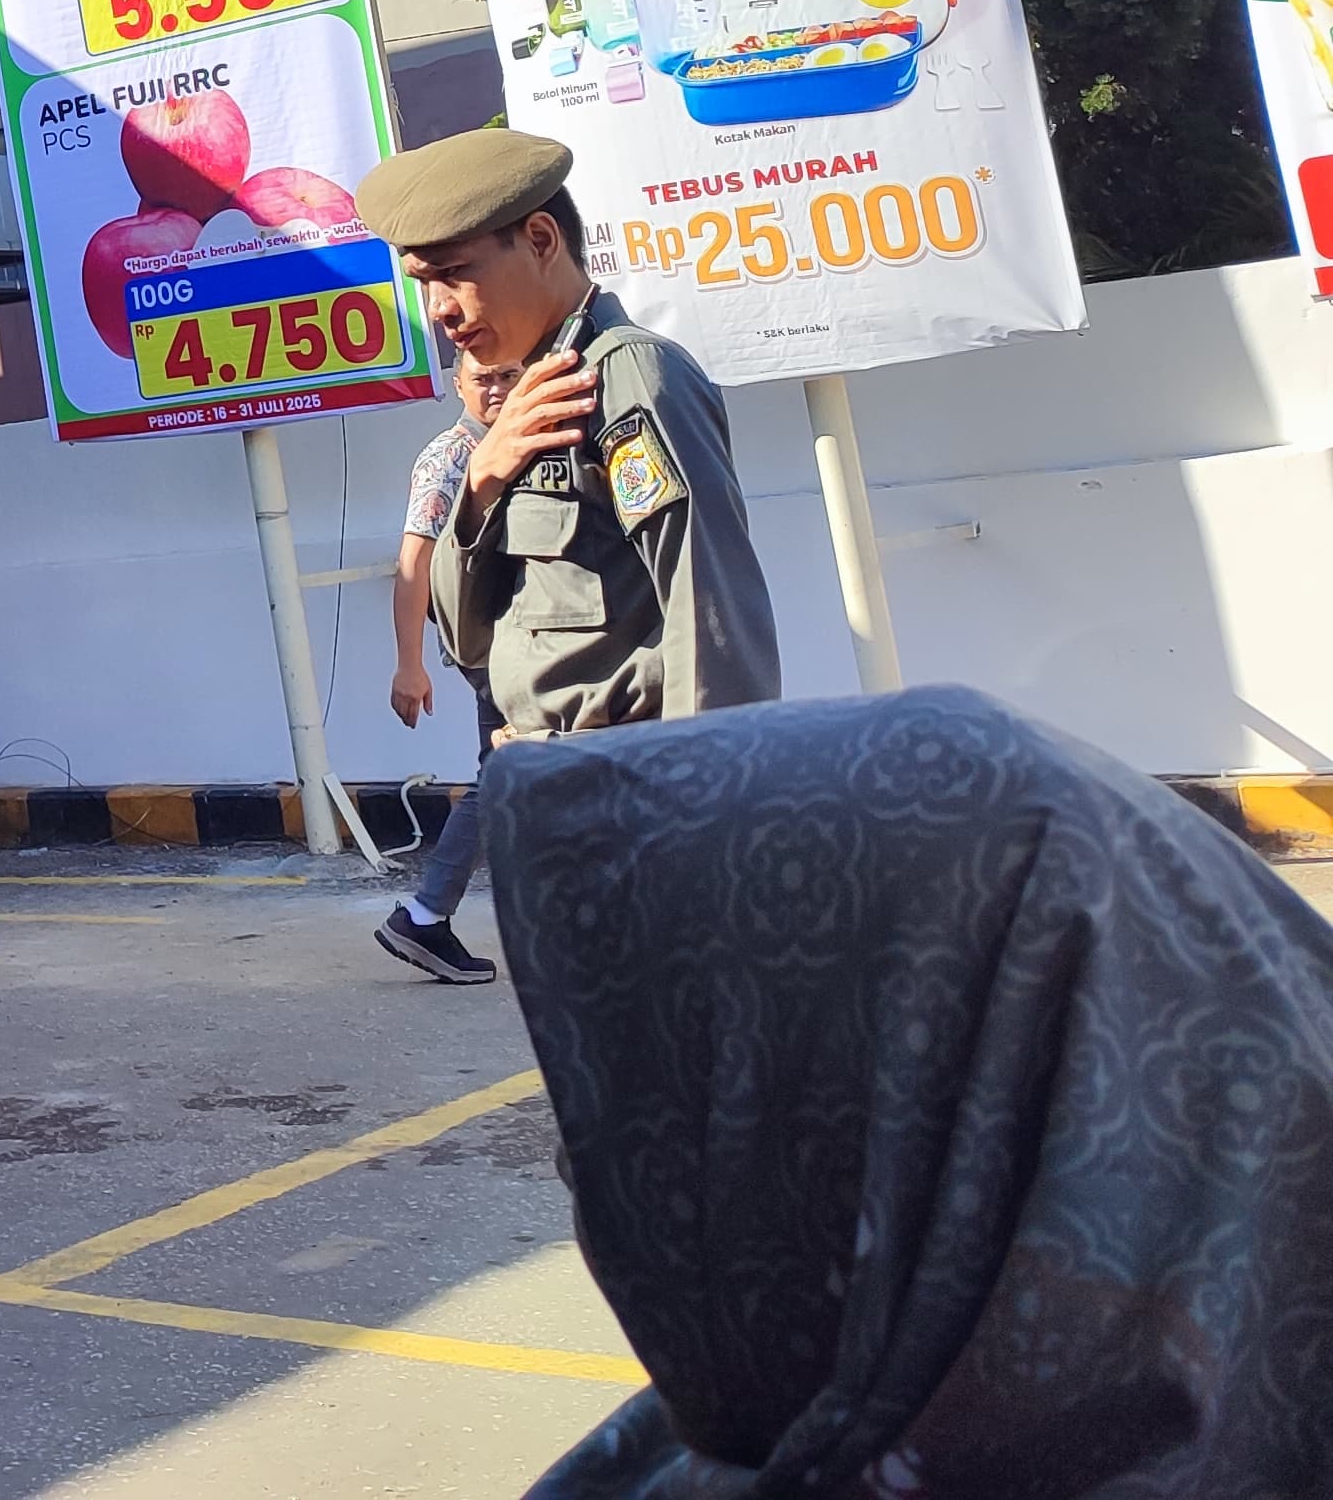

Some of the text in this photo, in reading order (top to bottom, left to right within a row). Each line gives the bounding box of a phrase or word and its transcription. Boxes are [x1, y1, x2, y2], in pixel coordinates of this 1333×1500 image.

[39, 62, 232, 128] APEL FUJI RRC
[560, 82, 598, 96] Minum
[561, 91, 600, 108] 1100 ml
[43, 125, 92, 156] PCS
[714, 124, 796, 145] Kotak Makan
[642, 150, 879, 206] TEBUS MURAH
[171, 249, 208, 264] dapat
[209, 238, 263, 258] berubah
[265, 229, 320, 248] sewaktu
[591, 251, 618, 275] ARI
[130, 278, 194, 311] 100G
[135, 289, 386, 388] Rp 4.750
[788, 324, 830, 336] berlaku
[148, 409, 206, 429] PERIODE
[212, 406, 227, 421] 16
[239, 402, 254, 417] 31
[255, 400, 284, 415] JULI
[286, 393, 322, 411] 2025
